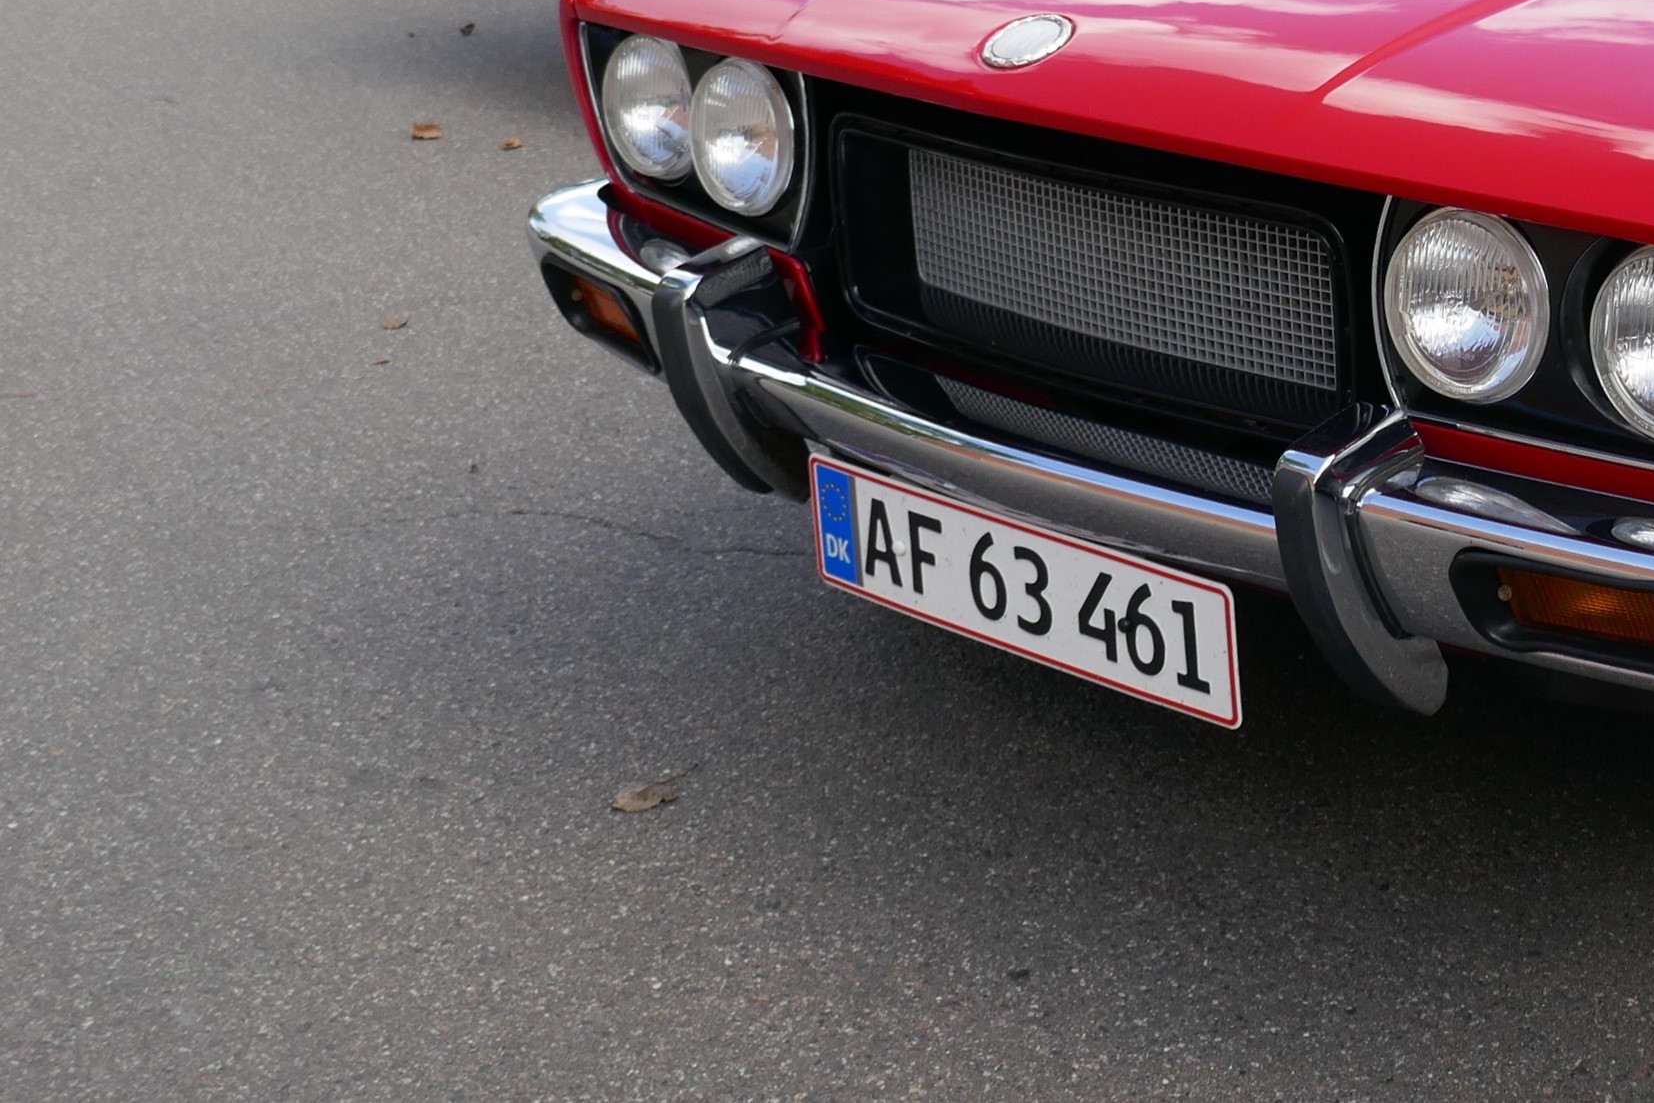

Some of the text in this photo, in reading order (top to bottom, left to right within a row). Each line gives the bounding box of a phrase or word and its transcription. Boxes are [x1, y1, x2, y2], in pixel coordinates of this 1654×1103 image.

[825, 532, 851, 565] DK
[864, 497, 1212, 696] AF 63 461
